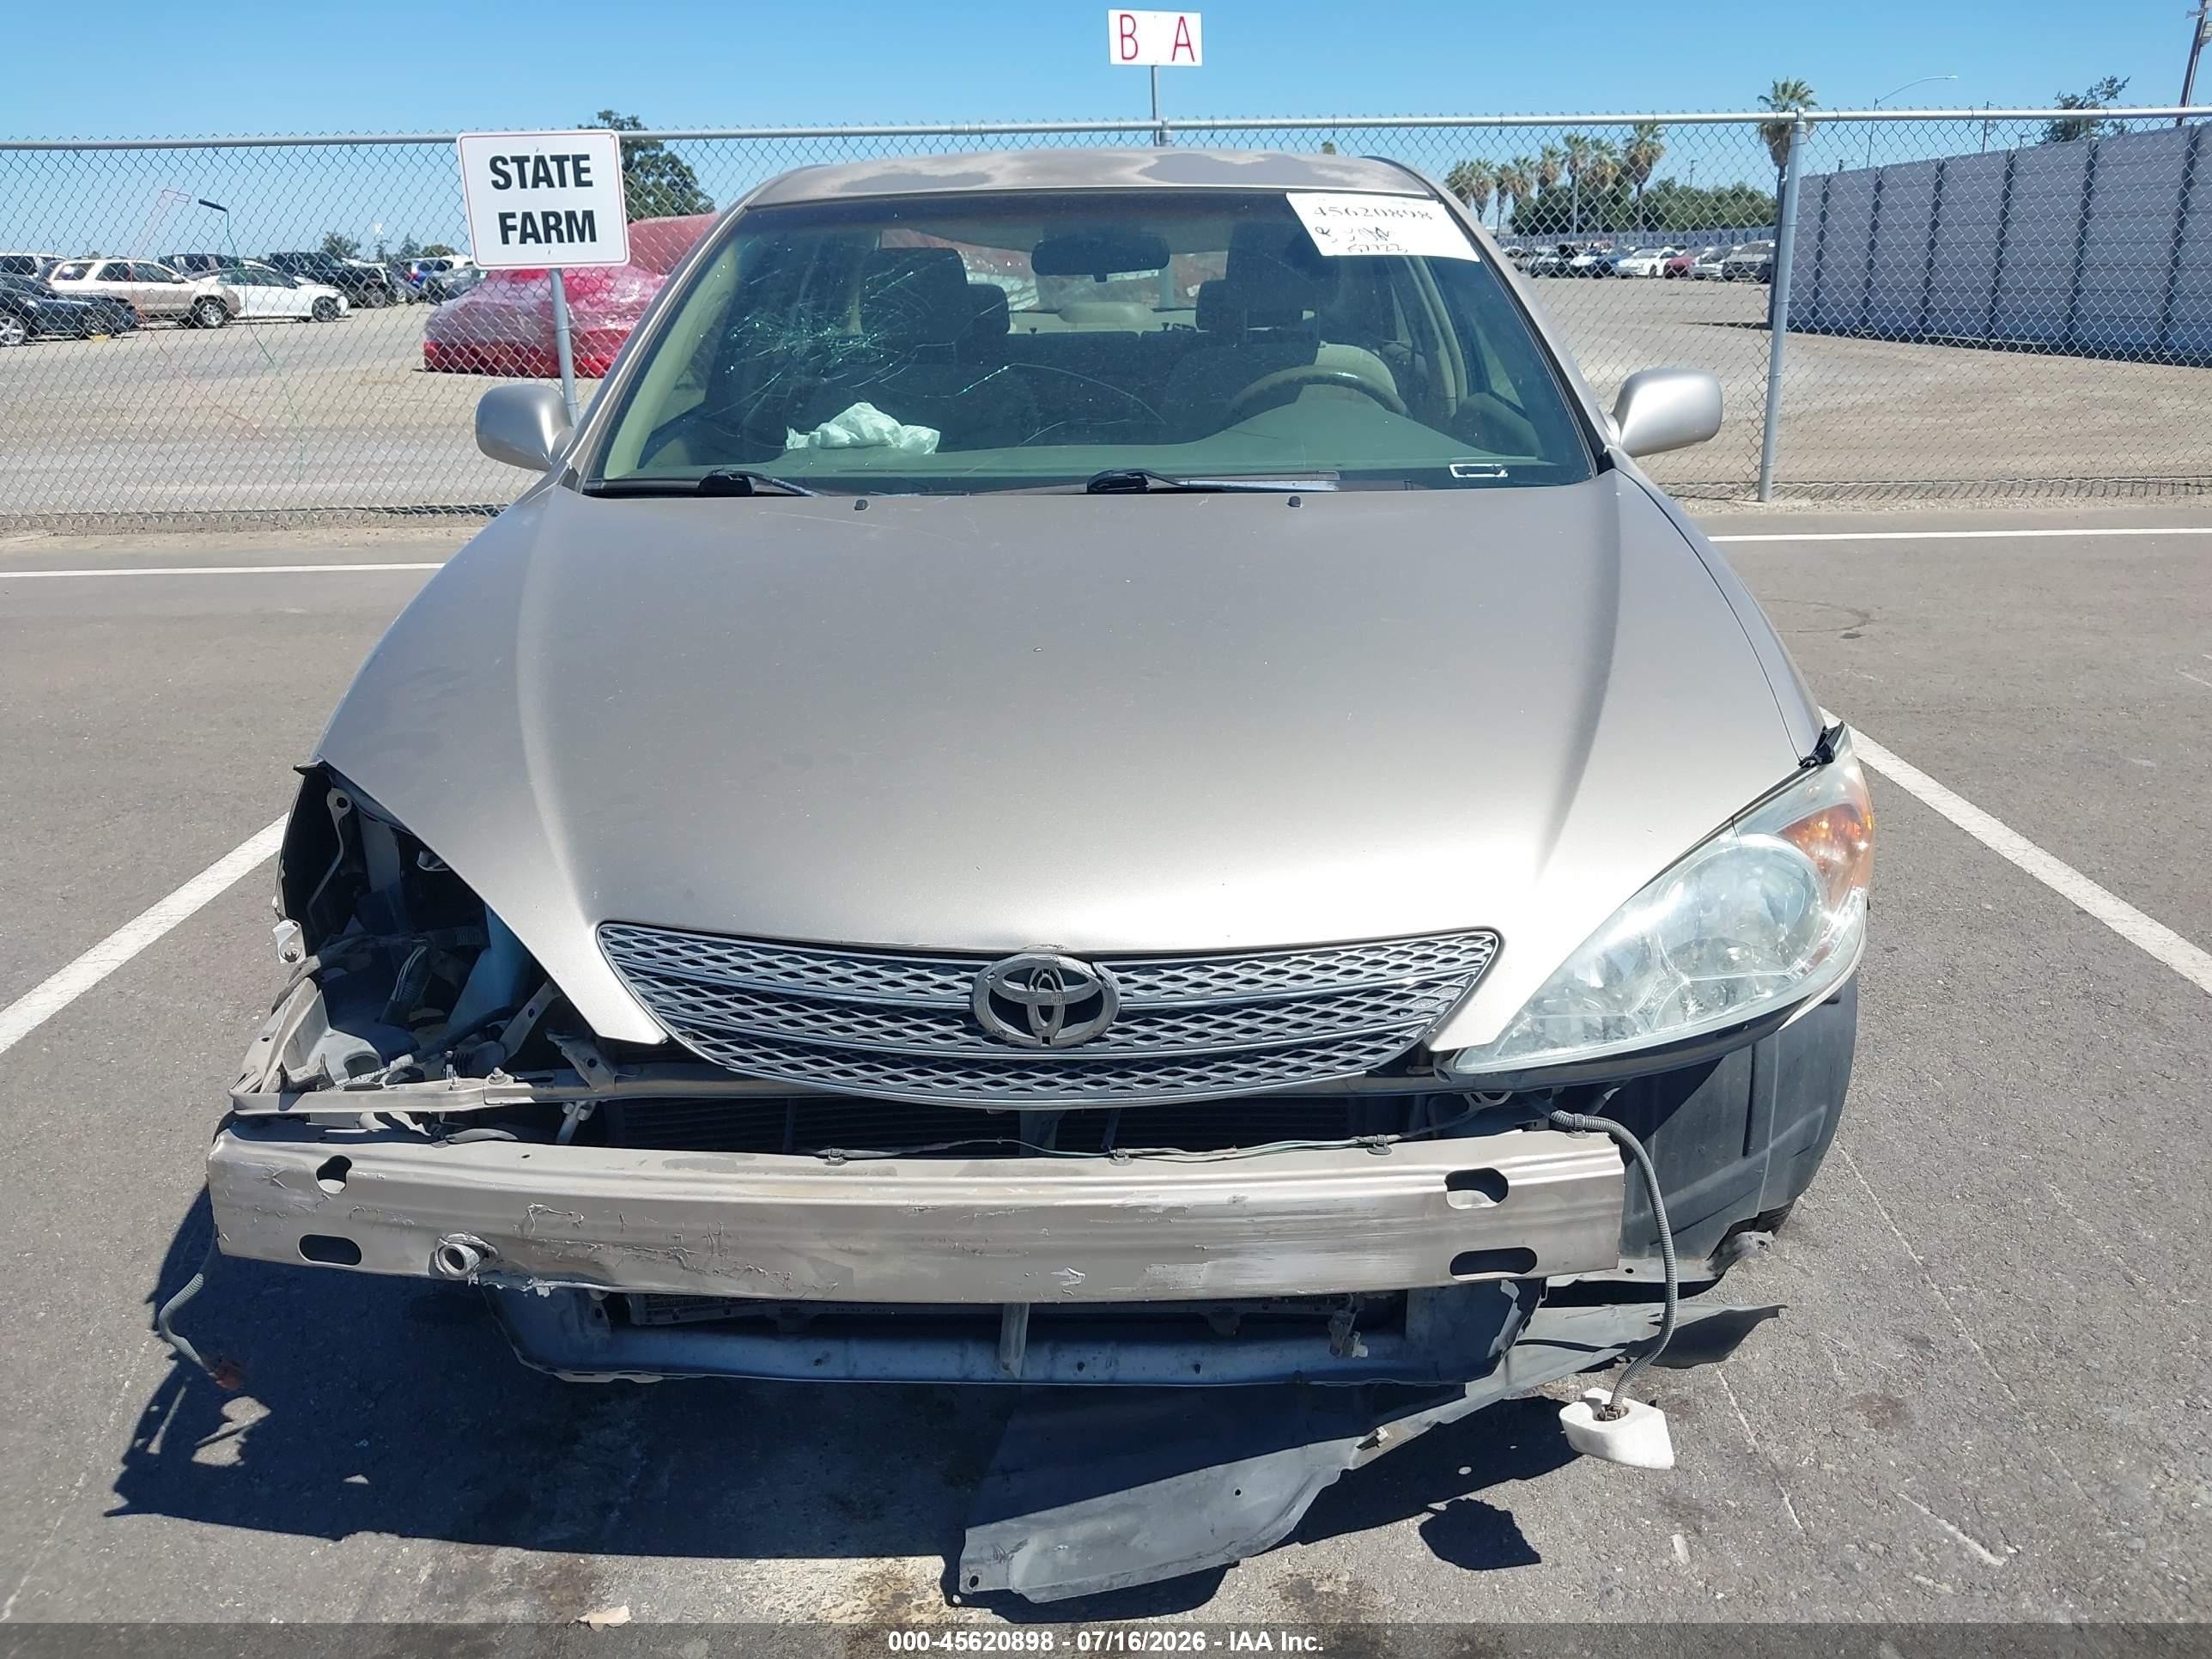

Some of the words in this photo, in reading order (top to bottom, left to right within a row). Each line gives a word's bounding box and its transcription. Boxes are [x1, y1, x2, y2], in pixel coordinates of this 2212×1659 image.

[1120, 14, 1139, 60] B
[1171, 15, 1195, 63] A
[489, 154, 594, 191] STATE
[498, 210, 598, 246] FARM
